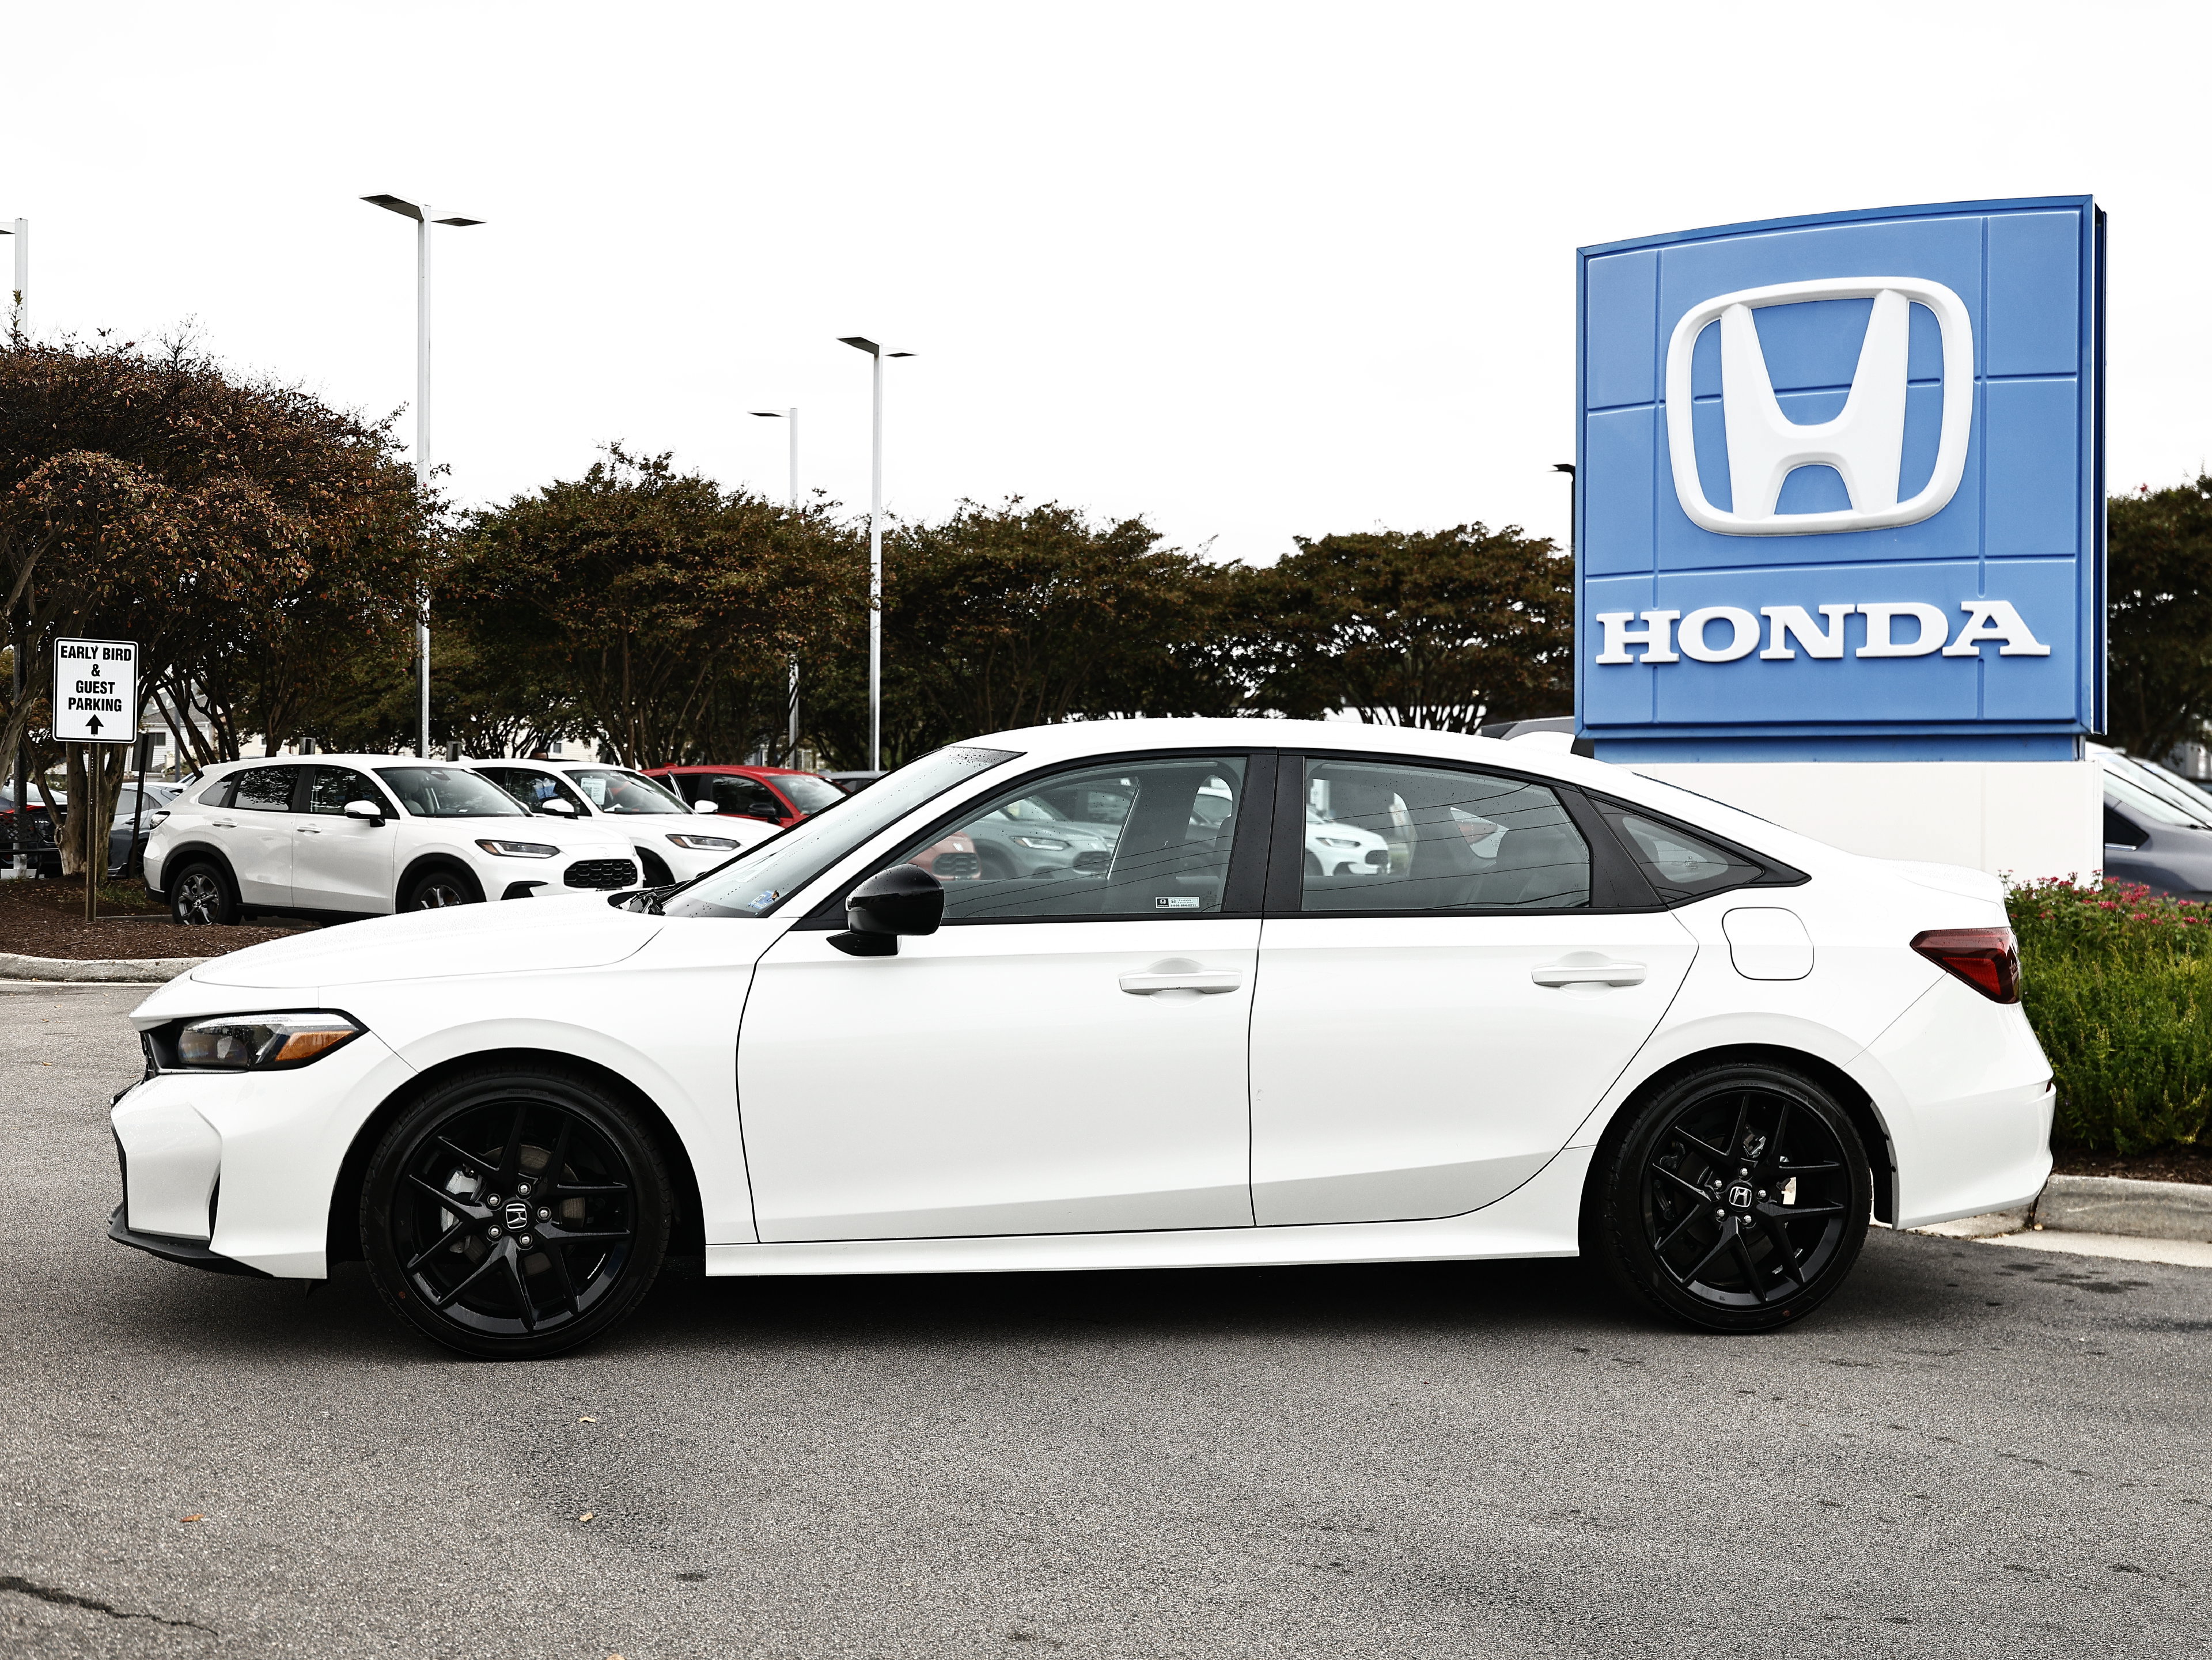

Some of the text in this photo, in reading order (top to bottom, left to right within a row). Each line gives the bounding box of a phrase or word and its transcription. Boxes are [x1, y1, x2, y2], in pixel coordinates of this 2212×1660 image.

[1595, 600, 2051, 665] HONDA
[60, 645, 132, 661] EARLY BIRD
[91, 664, 101, 677] &
[75, 680, 115, 694] GUEST
[68, 697, 122, 712] PARKING
